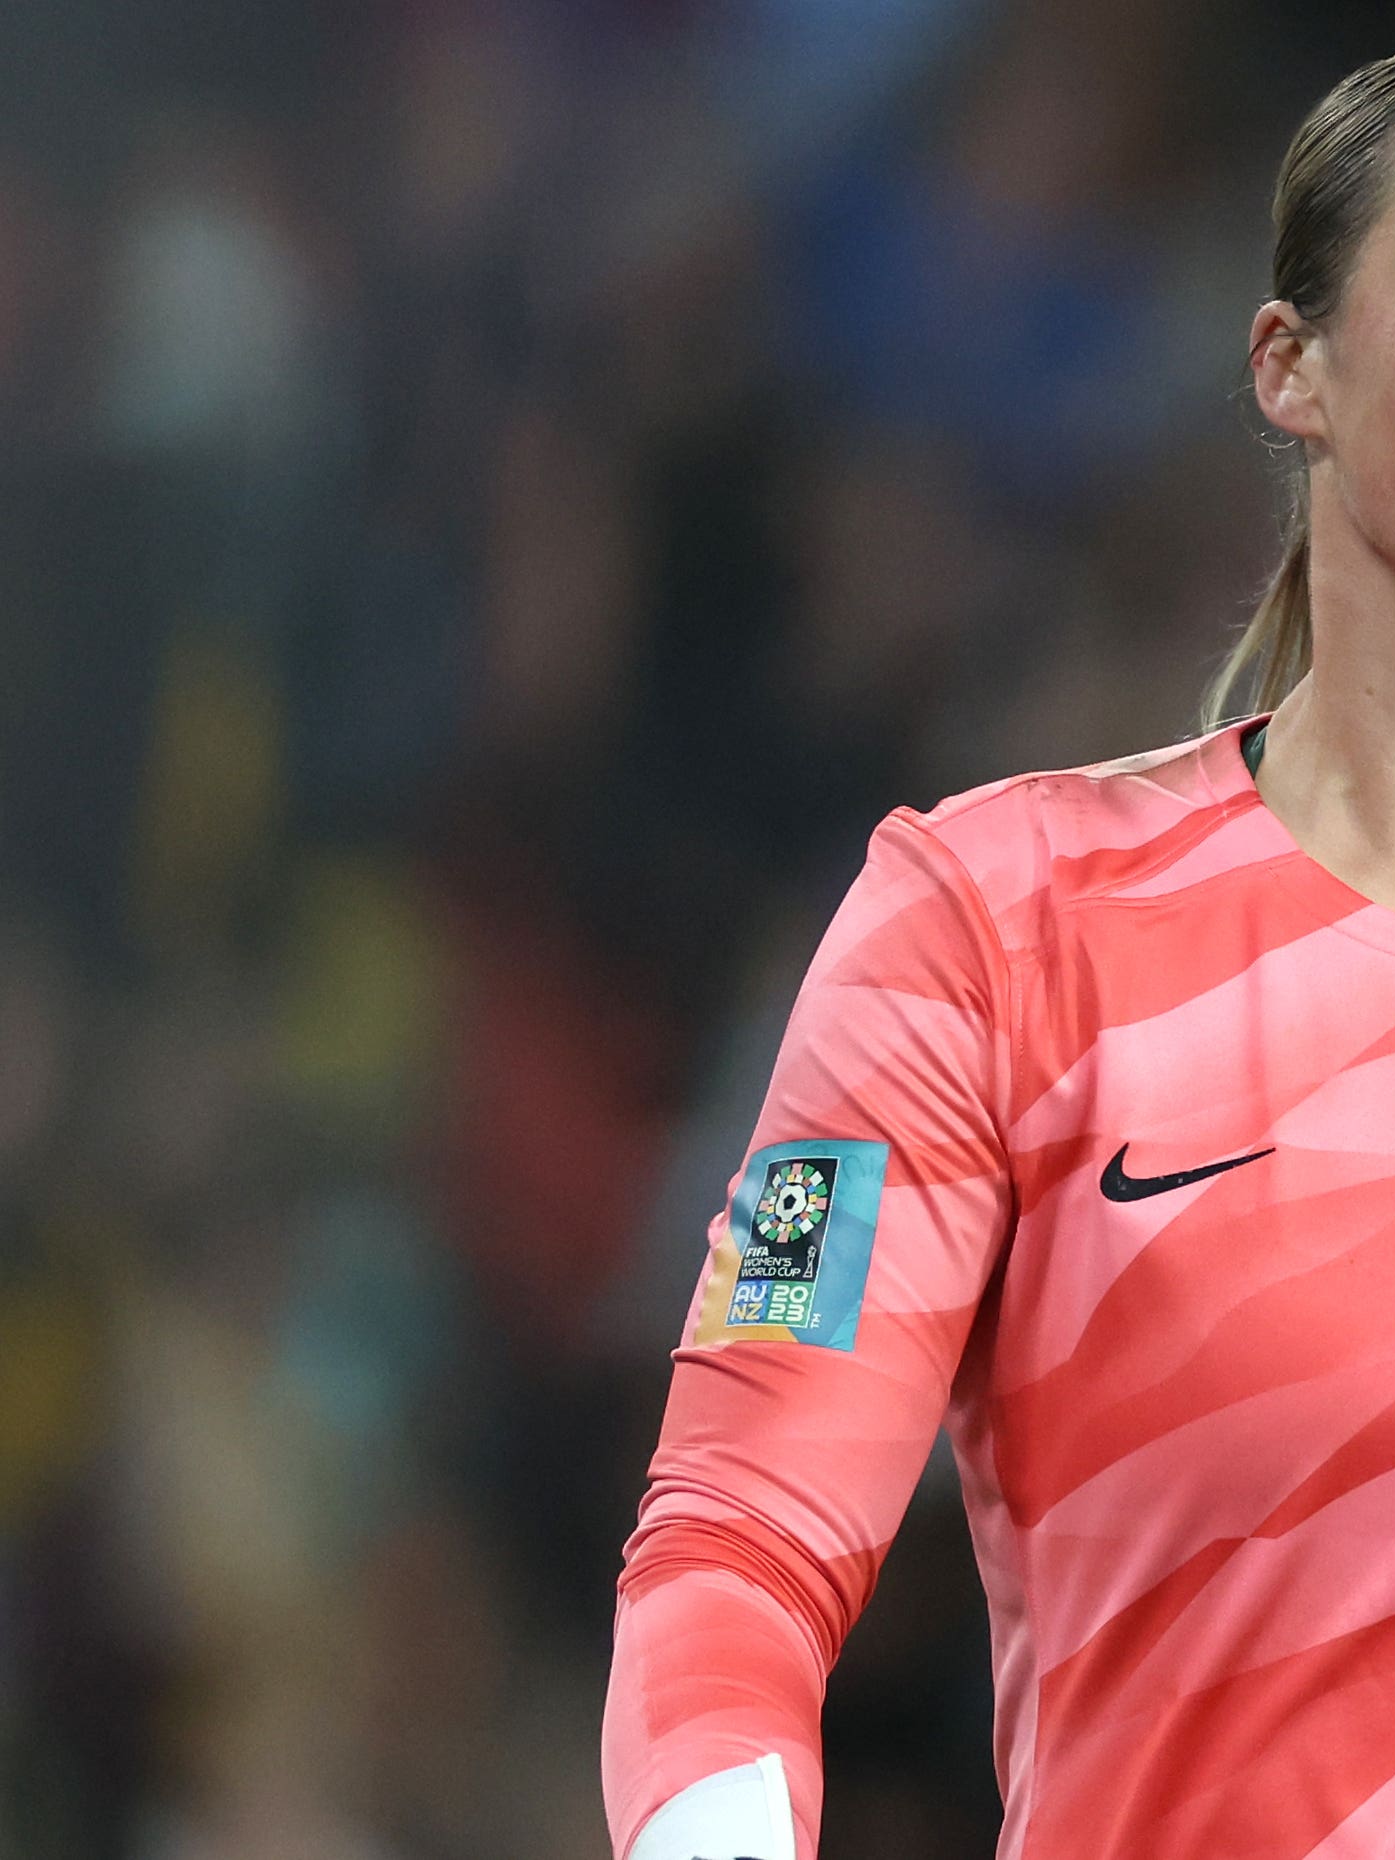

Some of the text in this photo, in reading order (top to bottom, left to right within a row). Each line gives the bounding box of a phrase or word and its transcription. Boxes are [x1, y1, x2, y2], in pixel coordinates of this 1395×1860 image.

[746, 1246, 769, 1258] FIFA
[743, 1256, 793, 1268] WOMEN'S
[741, 1267, 801, 1277] WORLD CUP
[734, 1284, 809, 1303] AU 20
[730, 1303, 805, 1322] NZ 23
